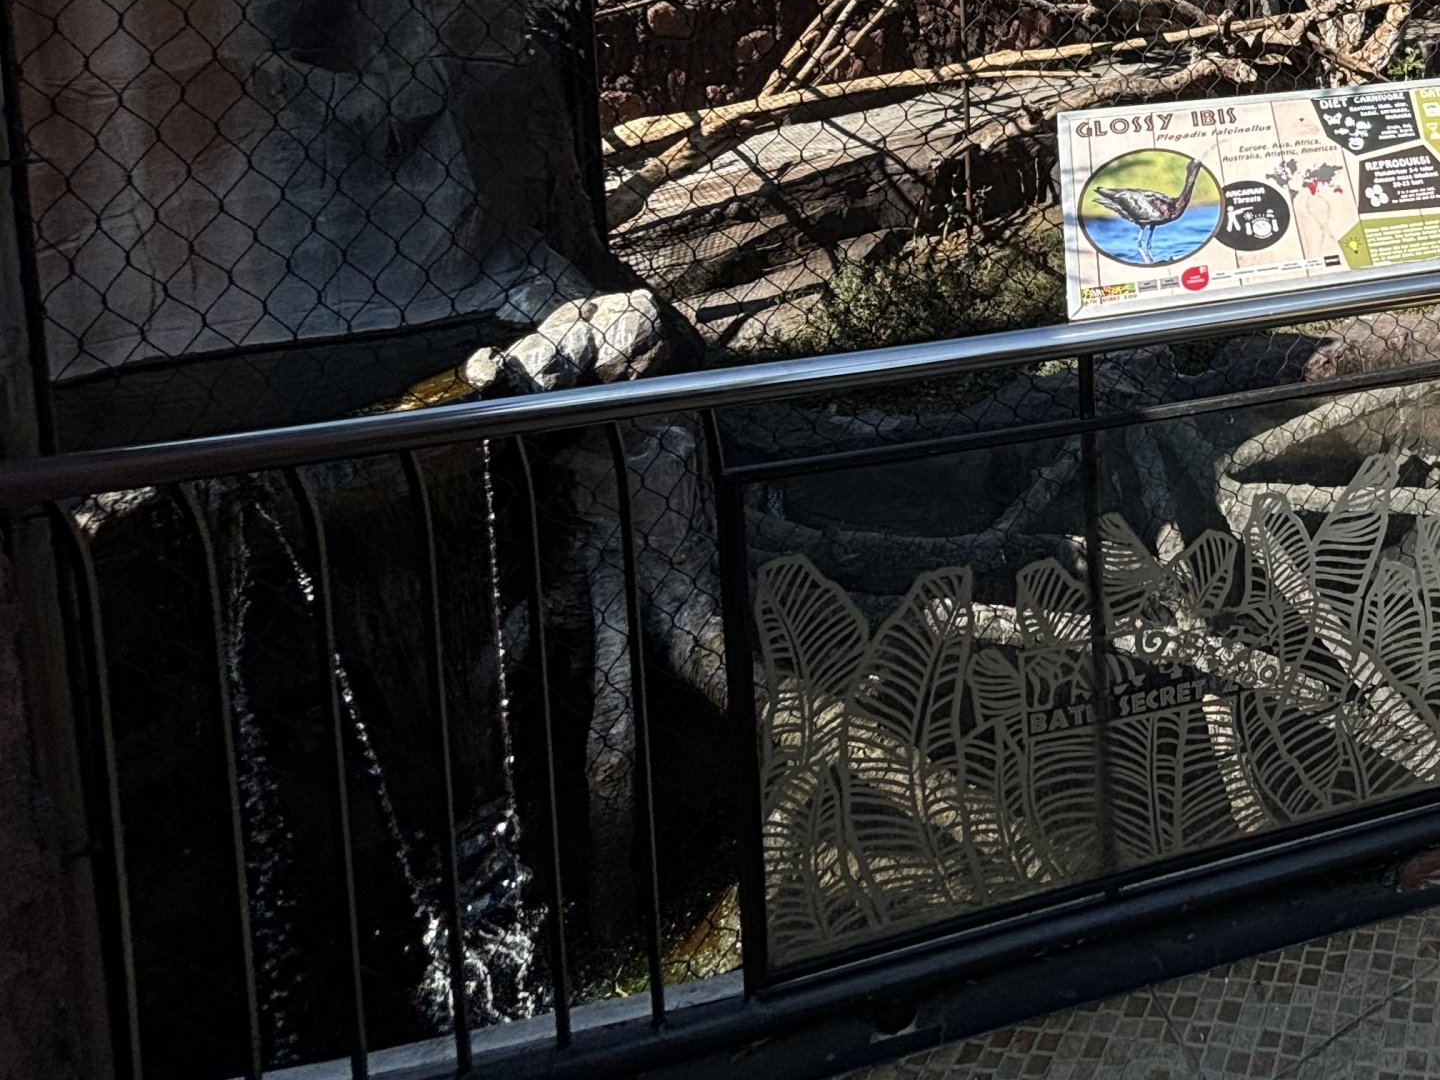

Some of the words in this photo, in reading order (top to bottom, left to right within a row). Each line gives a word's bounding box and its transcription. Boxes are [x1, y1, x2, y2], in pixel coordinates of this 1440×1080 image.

[1319, 98, 1348, 110] DIET
[1353, 92, 1405, 104] CARNIVORE
[1076, 113, 1173, 138] GLOSSY
[1191, 107, 1237, 127] IBIS
[1156, 130, 1206, 142] Plegadis
[1211, 124, 1271, 137] falcinellus
[1365, 156, 1431, 171] REPRODUKSI
[1119, 679, 1206, 716] SECRET
